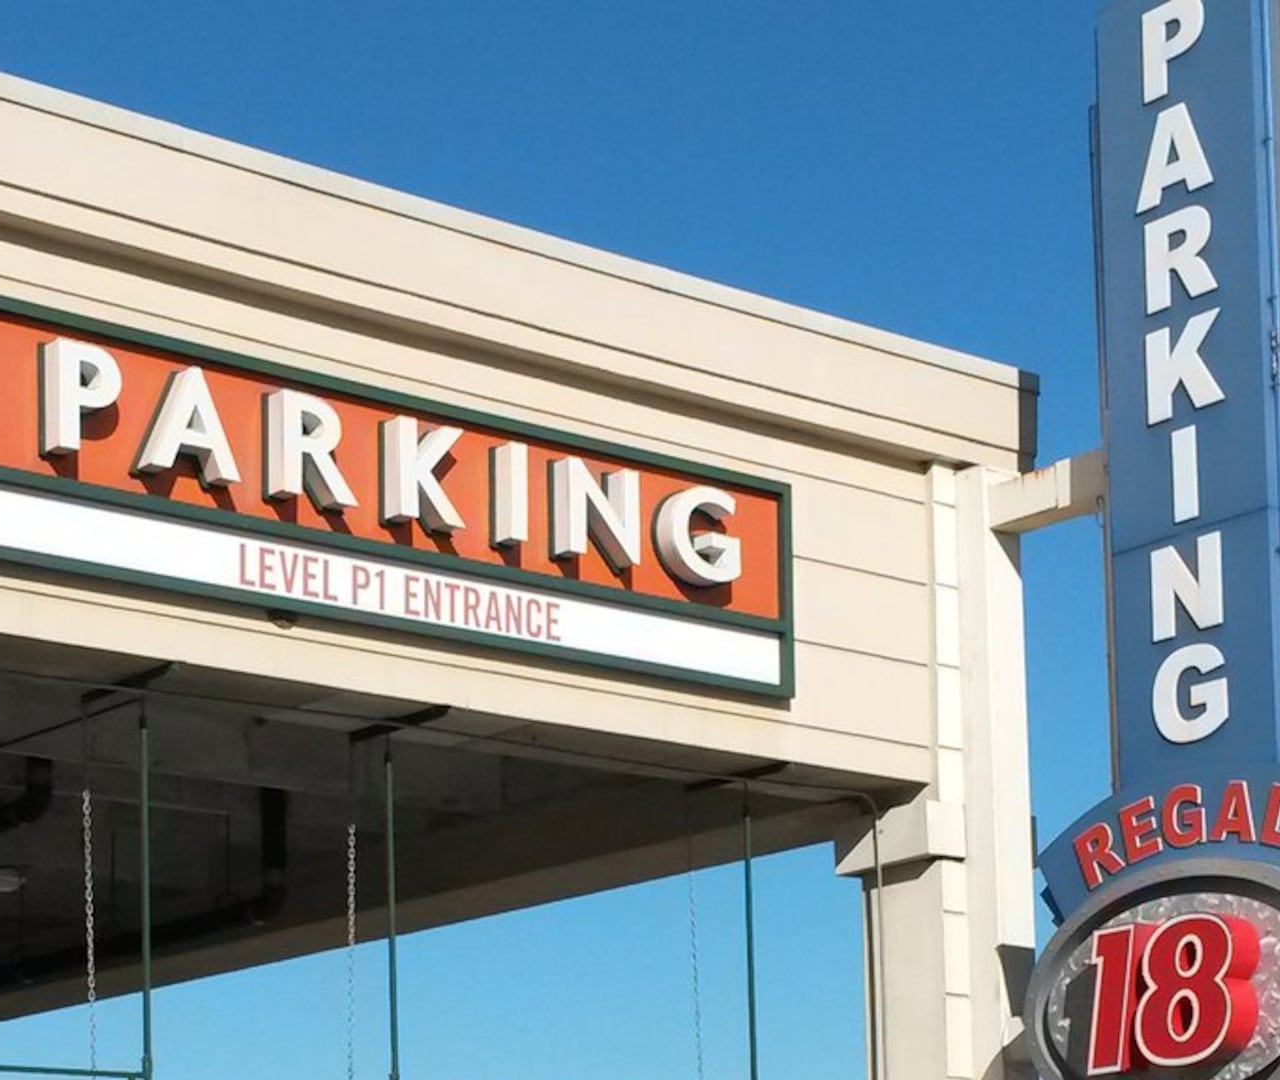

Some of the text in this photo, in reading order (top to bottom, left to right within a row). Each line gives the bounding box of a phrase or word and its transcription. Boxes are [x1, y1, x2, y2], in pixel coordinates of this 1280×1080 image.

[38, 336, 743, 588] PARKING
[1135, 0, 1230, 744] PARKING
[238, 543, 562, 642] LEVEL P1 ENTRANCE
[1087, 913, 1235, 1078] 18
